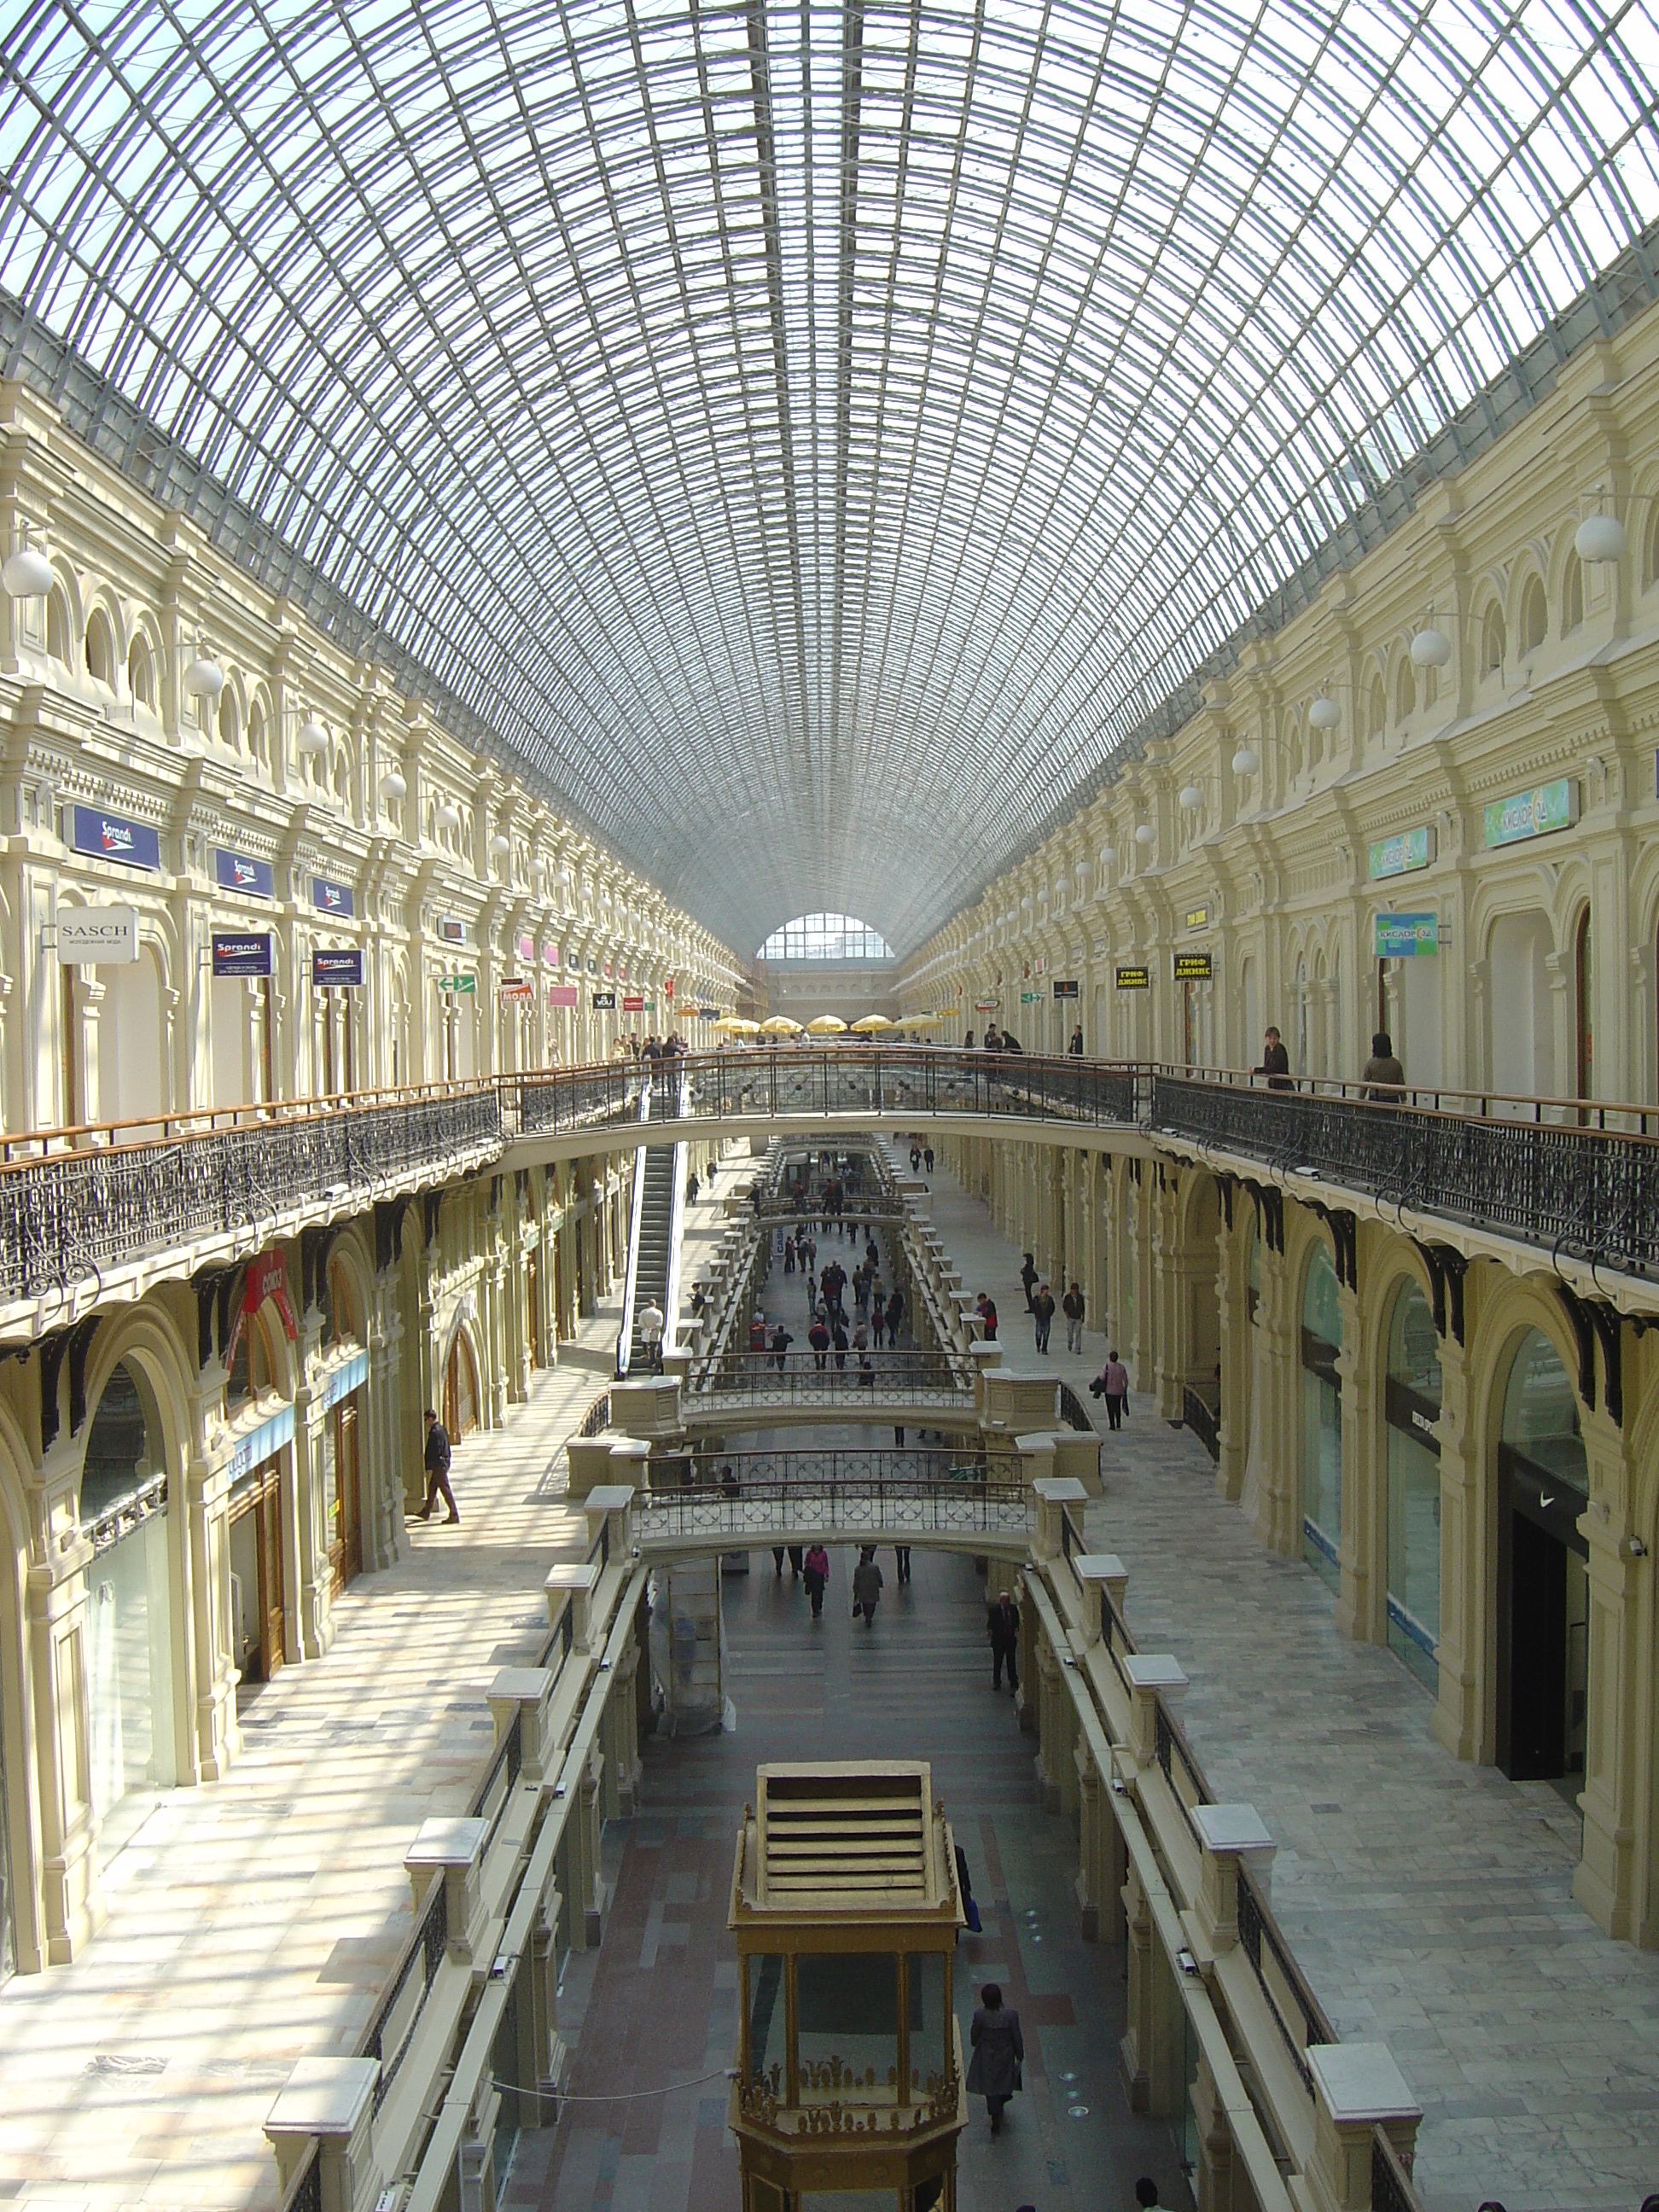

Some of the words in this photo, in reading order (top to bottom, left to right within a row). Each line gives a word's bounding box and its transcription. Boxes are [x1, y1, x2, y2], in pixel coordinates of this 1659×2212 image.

[102, 821, 131, 841] Sprandi
[234, 859, 255, 876] Sprandi
[62, 926, 127, 936] SASCH
[217, 942, 261, 952] Sprandi
[317, 957, 354, 965] Sprandi
[1176, 967, 1210, 976] ДЖИНС
